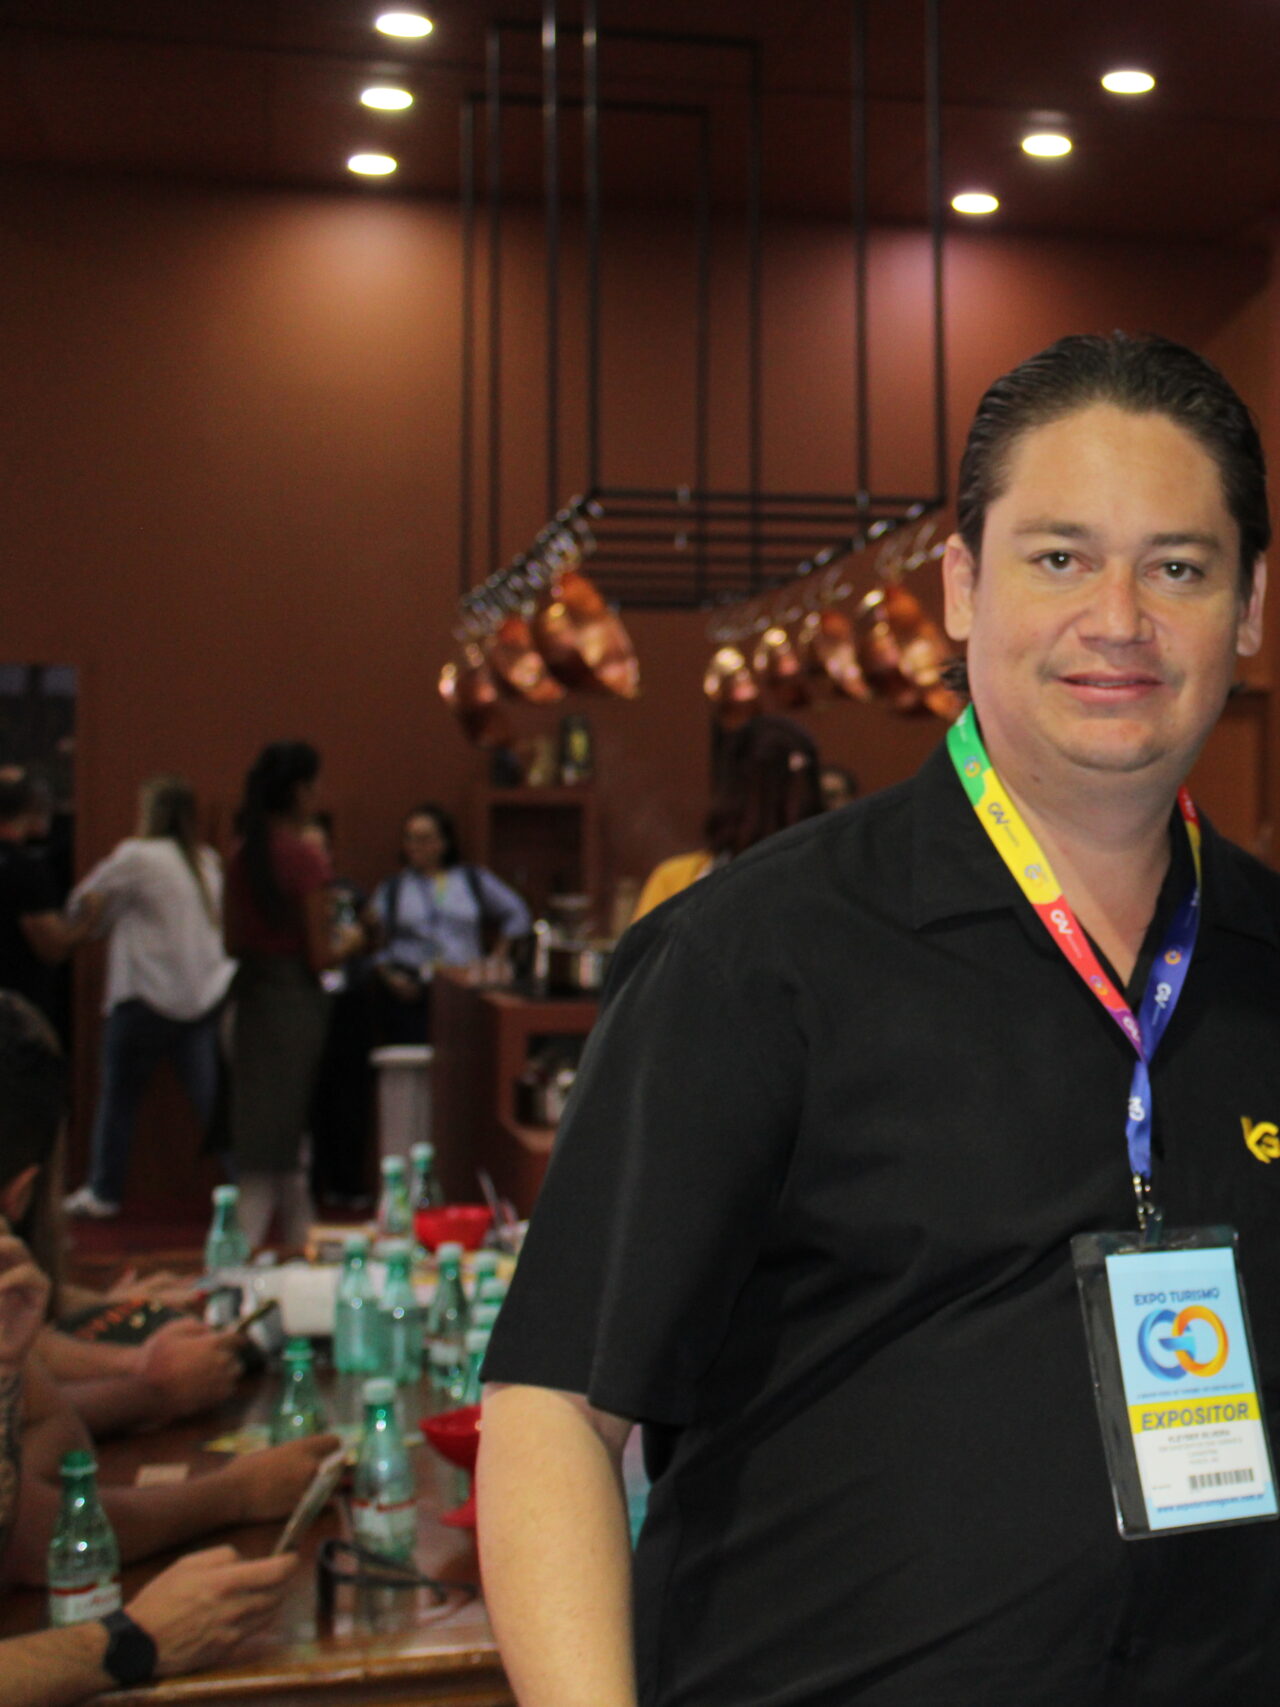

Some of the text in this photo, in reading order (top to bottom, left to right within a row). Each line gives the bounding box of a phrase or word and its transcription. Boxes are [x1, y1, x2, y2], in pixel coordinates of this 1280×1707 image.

[1133, 1287, 1220, 1306] EXPO TURISMO
[1141, 1402, 1248, 1431] EXPOSITOR
